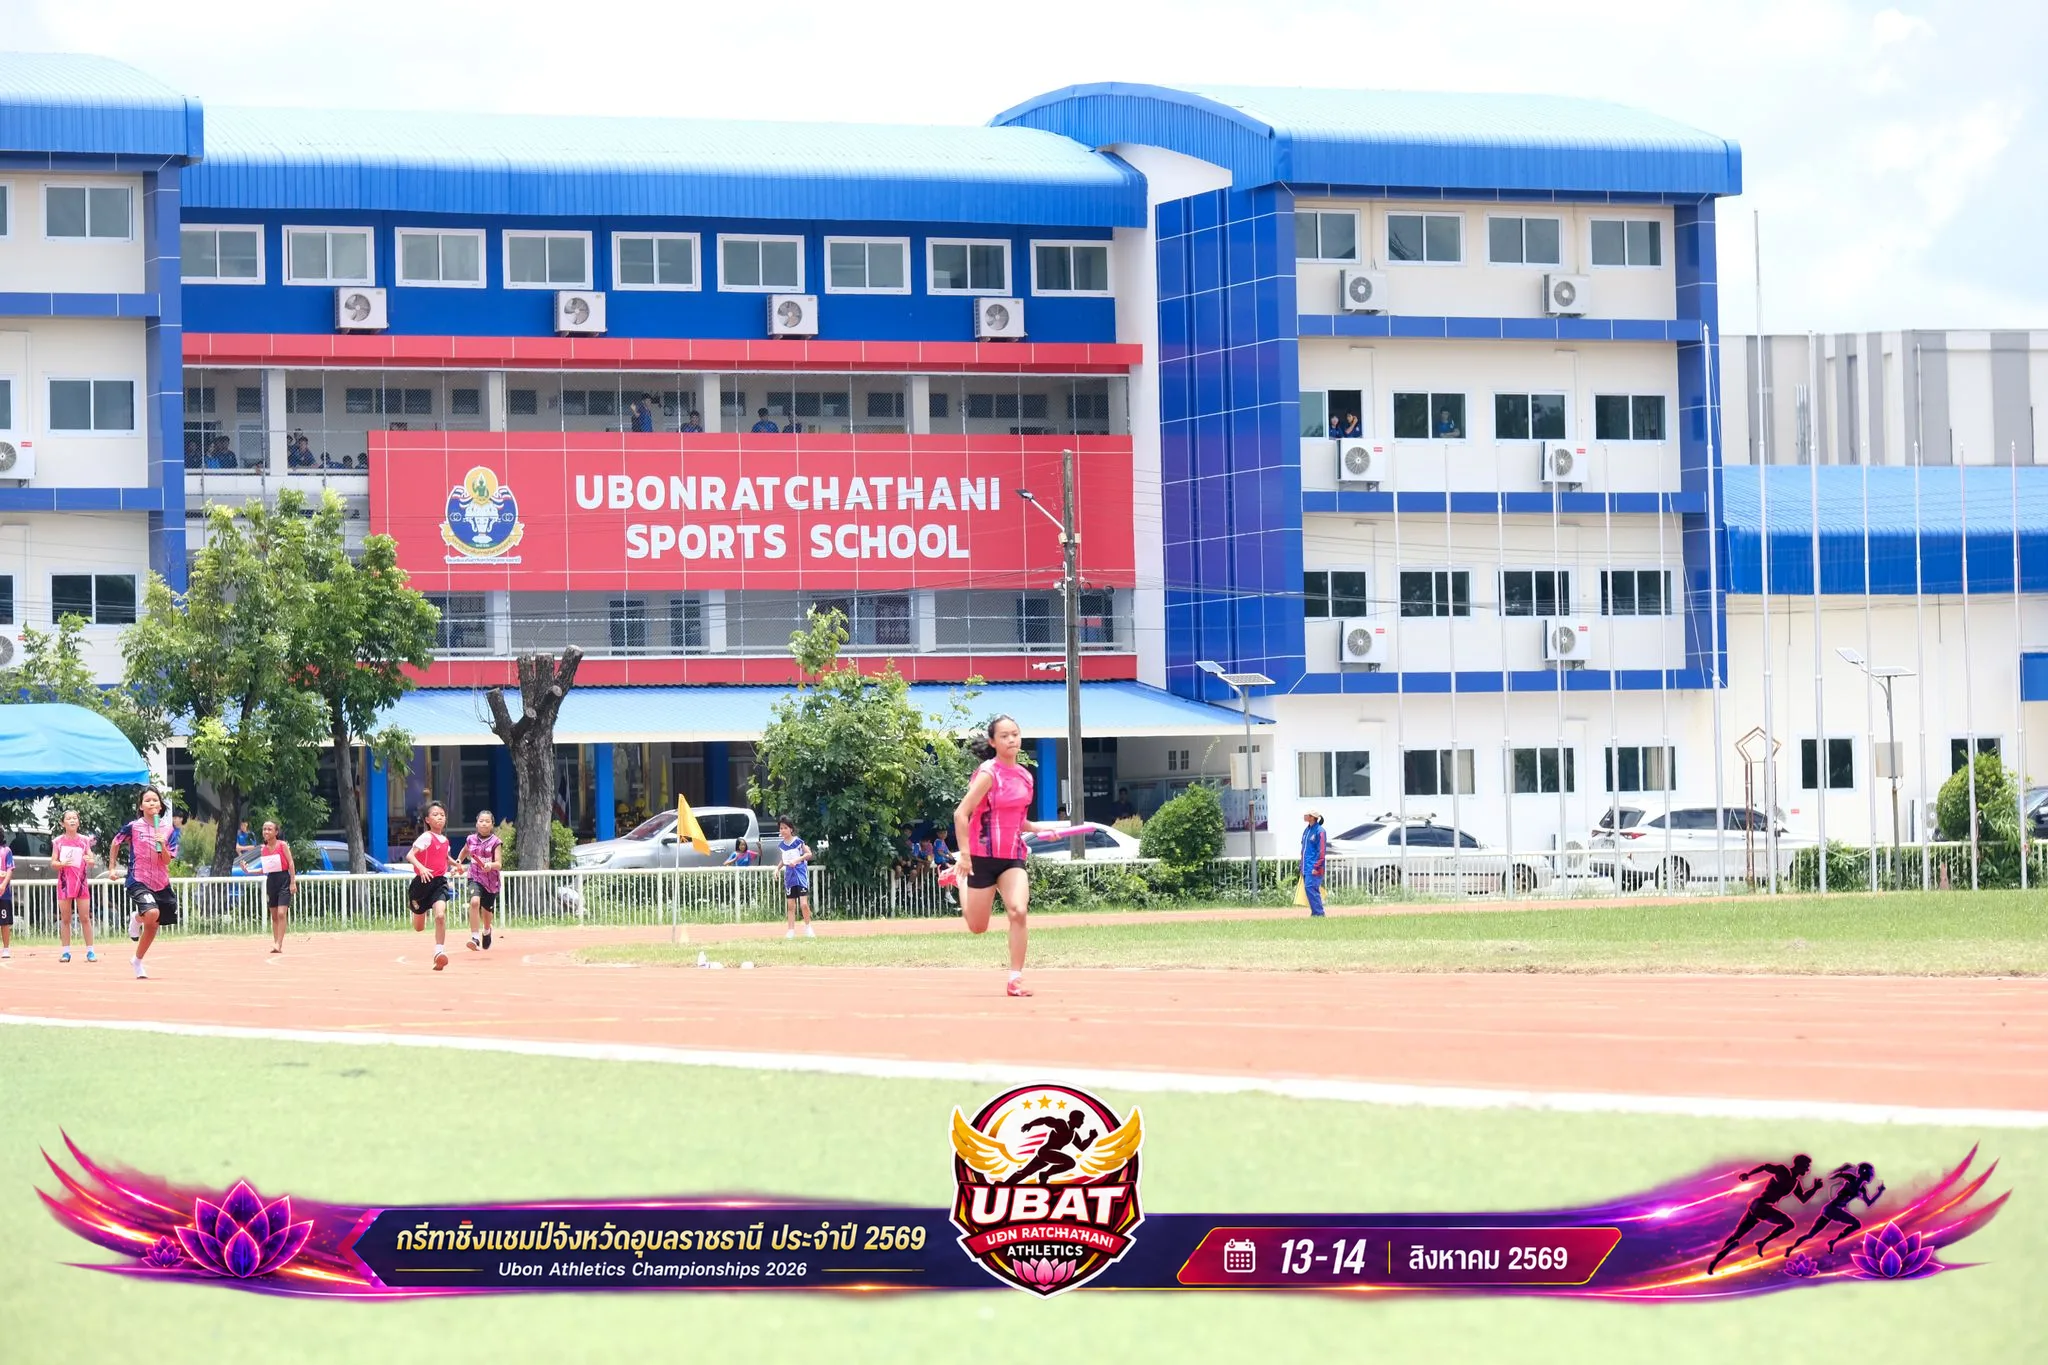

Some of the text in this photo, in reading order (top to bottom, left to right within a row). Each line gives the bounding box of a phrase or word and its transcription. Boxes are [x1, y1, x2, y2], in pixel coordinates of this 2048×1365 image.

[575, 475, 1000, 511] UBONRATCHATHANI
[626, 523, 970, 560] SPORTS SCHOOL
